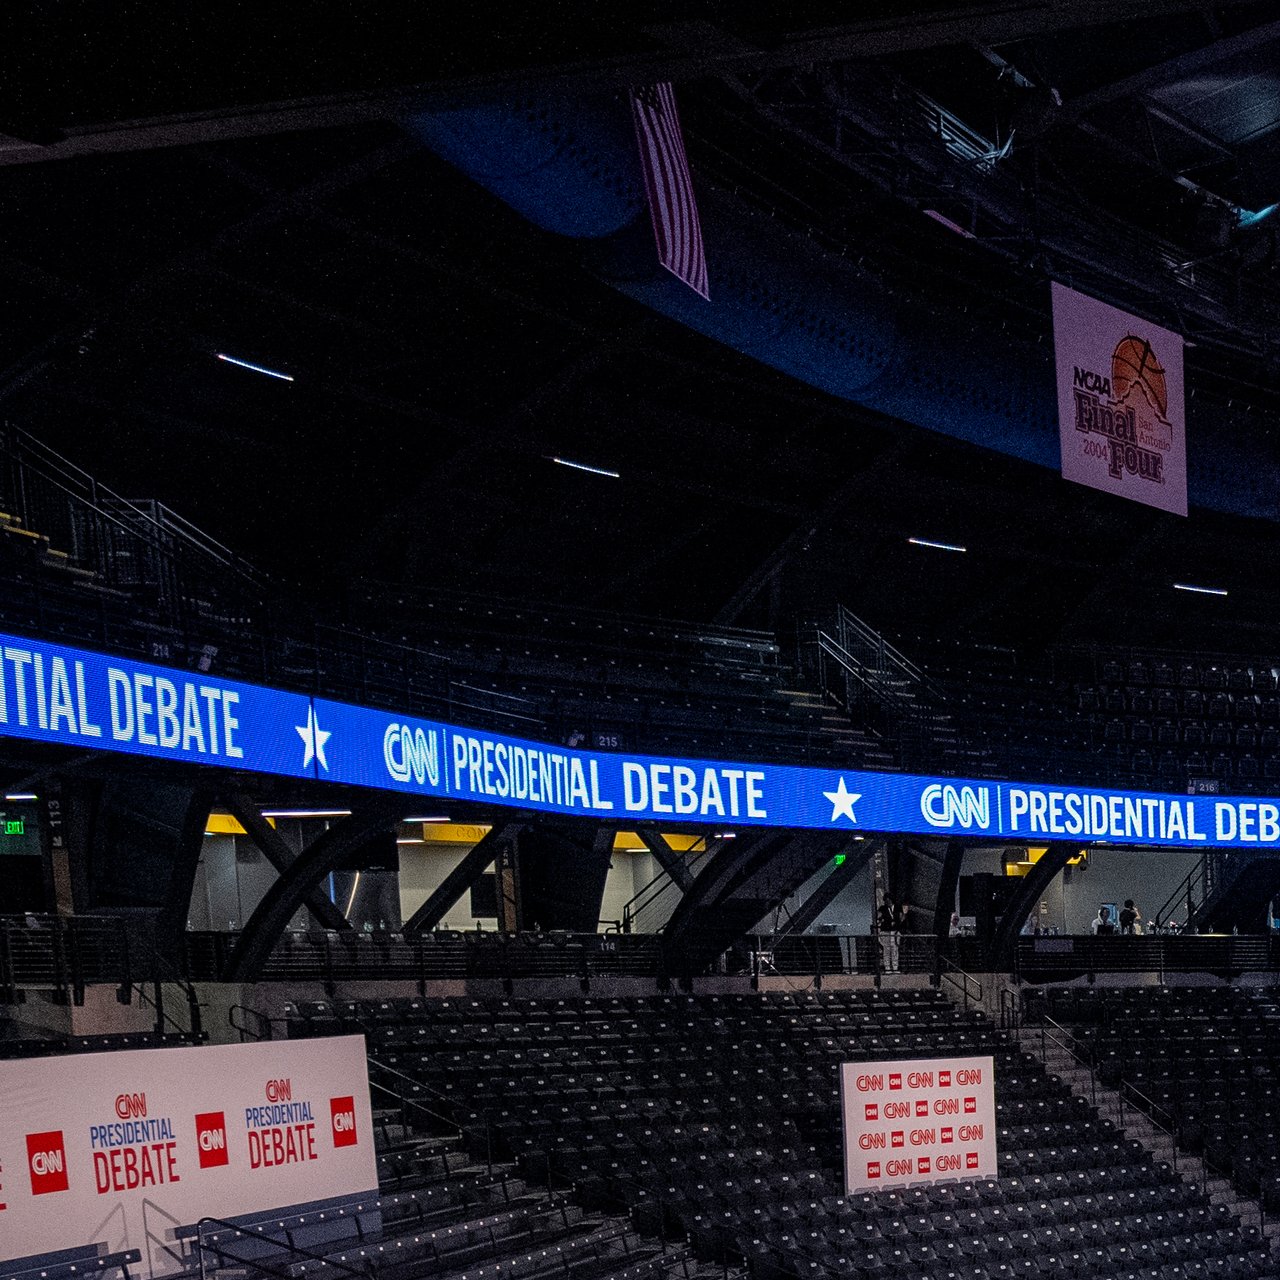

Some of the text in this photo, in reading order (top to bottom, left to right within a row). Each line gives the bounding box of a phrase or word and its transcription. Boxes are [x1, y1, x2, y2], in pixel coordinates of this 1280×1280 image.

[1073, 366, 1110, 397] NCAA
[1073, 388, 1138, 445] Final
[1083, 438, 1109, 461] 2004
[1138, 431, 1171, 451] Antonio
[1108, 440, 1163, 484] Four
[108, 668, 244, 758] DEBATE
[382, 722, 767, 818] CNN PRESIDENTIAL DEBATE
[920, 784, 990, 829] CNN
[1009, 789, 1206, 841] PRESIDENTIAL
[265, 1078, 291, 1103] CNN
[856, 1069, 982, 1092] CNN CNN CNN
[115, 1092, 147, 1119] CNN
[245, 1101, 315, 1129] PRESIDENTIAL
[90, 1117, 176, 1149] PRESIDENTIAL
[333, 1111, 354, 1133] CNN
[200, 1123, 318, 1169] CNN DEBATE
[32, 1141, 181, 1194] CNN DEBATE
